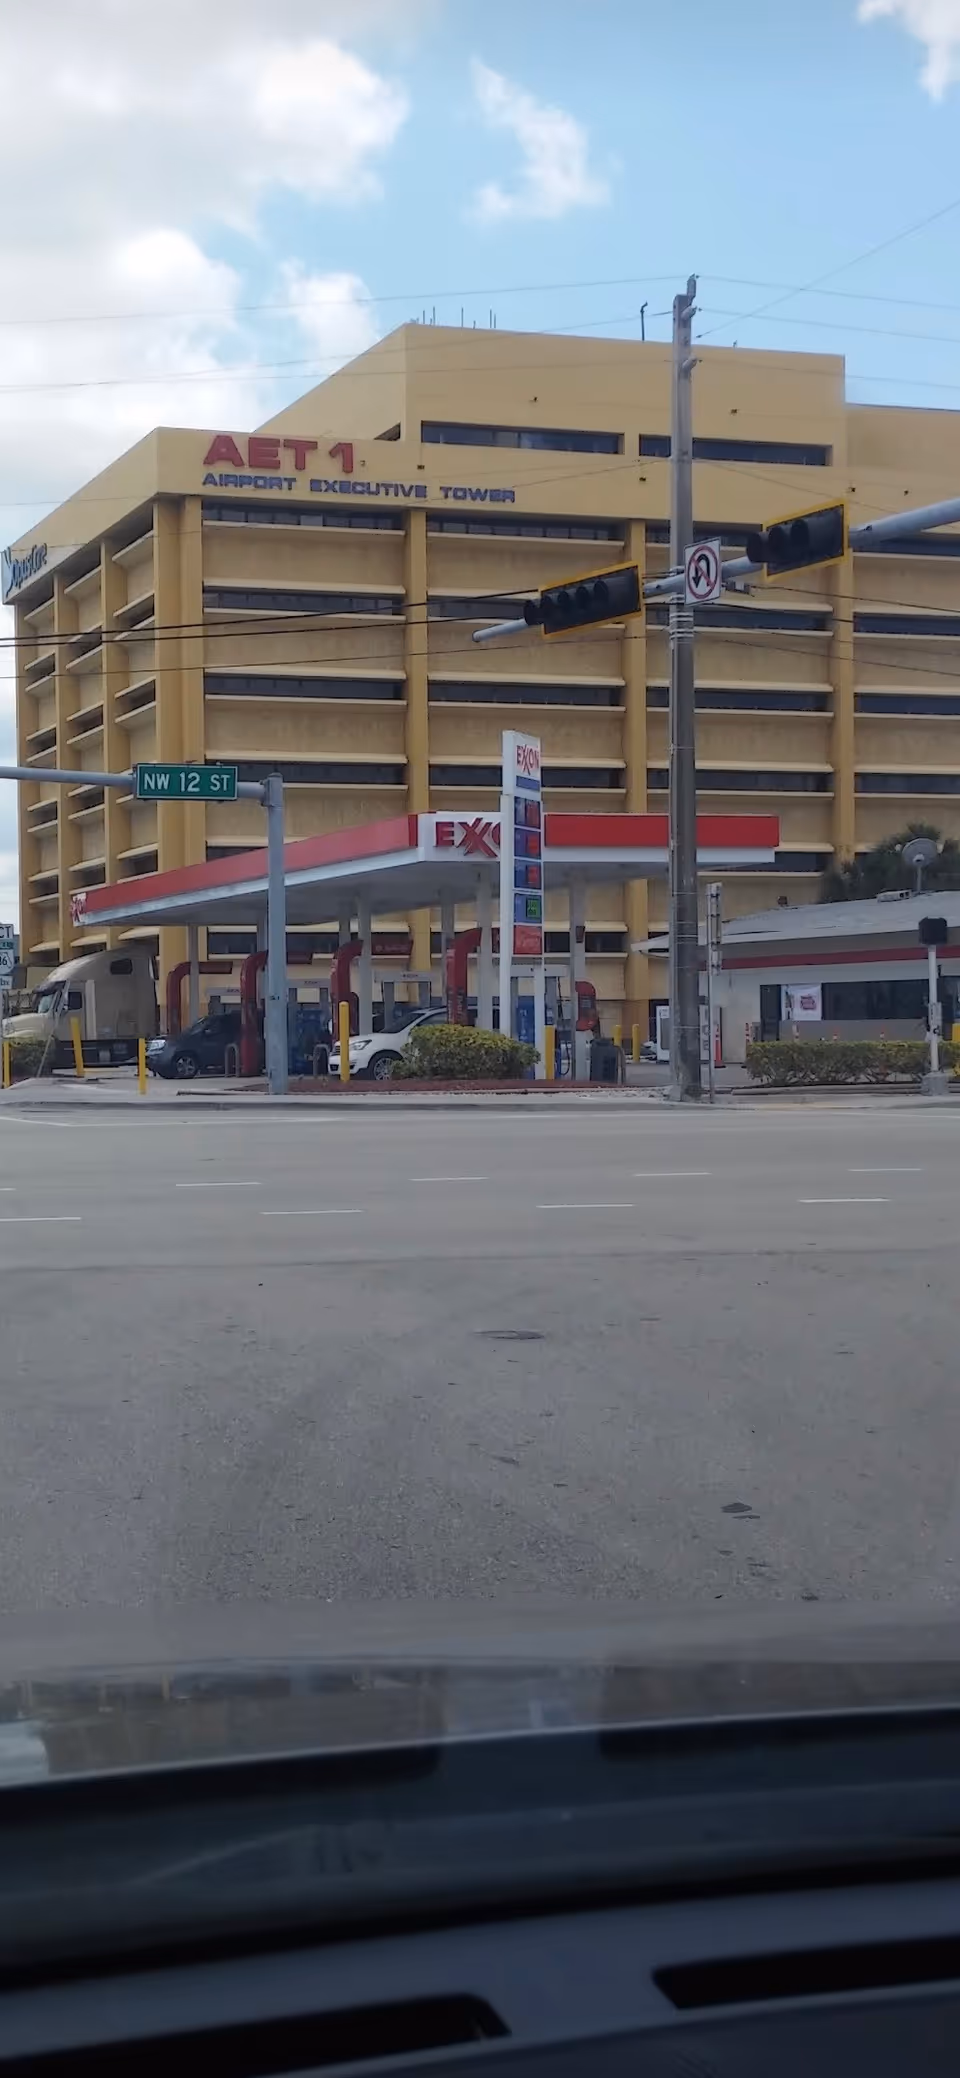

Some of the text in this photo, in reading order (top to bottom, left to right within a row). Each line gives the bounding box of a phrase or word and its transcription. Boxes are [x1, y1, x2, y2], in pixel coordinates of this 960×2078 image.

[203, 435, 354, 473] AET 1
[202, 472, 516, 503] AIRPORT EXECUTIVE TOWER
[516, 744, 540, 776] EXXON
[144, 771, 231, 792] NW 12 ST
